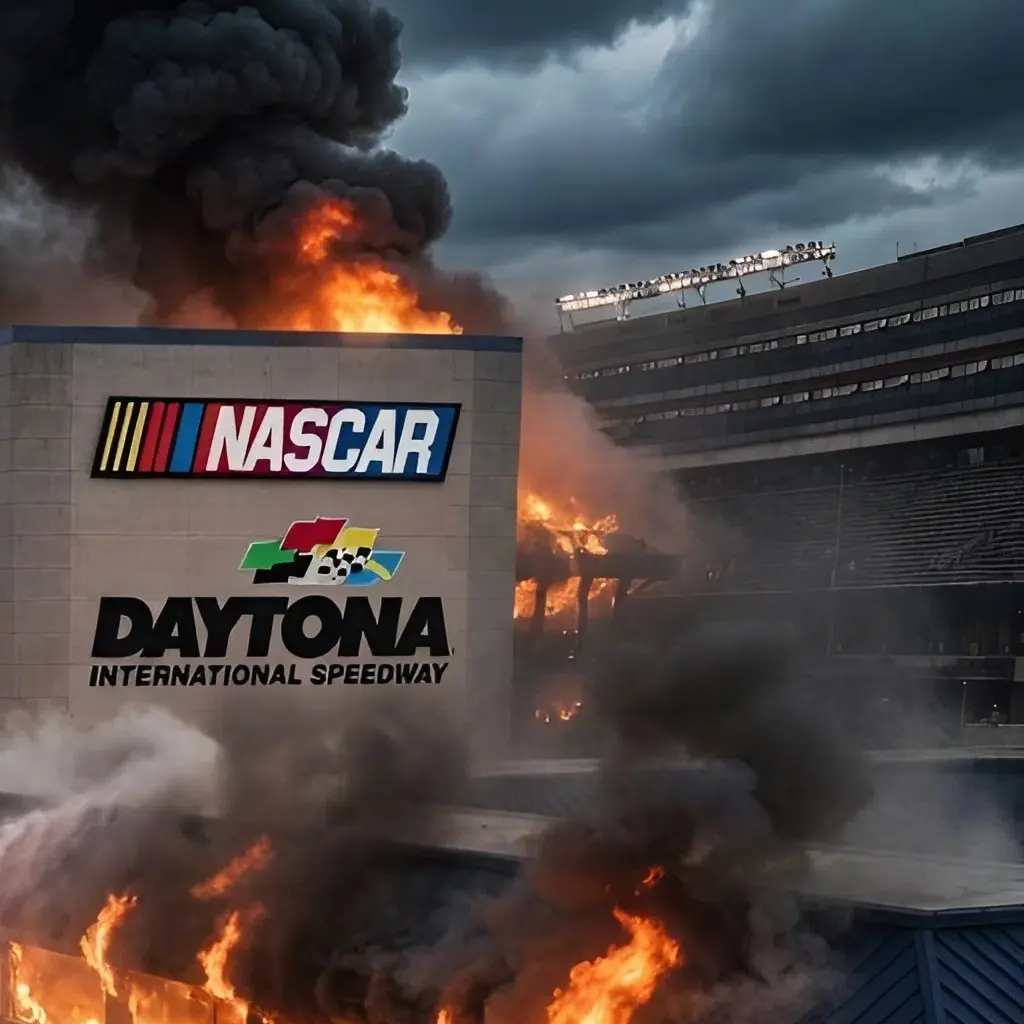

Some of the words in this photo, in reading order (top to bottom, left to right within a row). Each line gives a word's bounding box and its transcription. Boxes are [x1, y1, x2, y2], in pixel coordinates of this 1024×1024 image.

[205, 405, 439, 474] NASCAR
[91, 595, 450, 658] DAYTONA
[89, 664, 302, 687] INTERNATIONAL
[310, 662, 449, 686] SPEEDWAY
